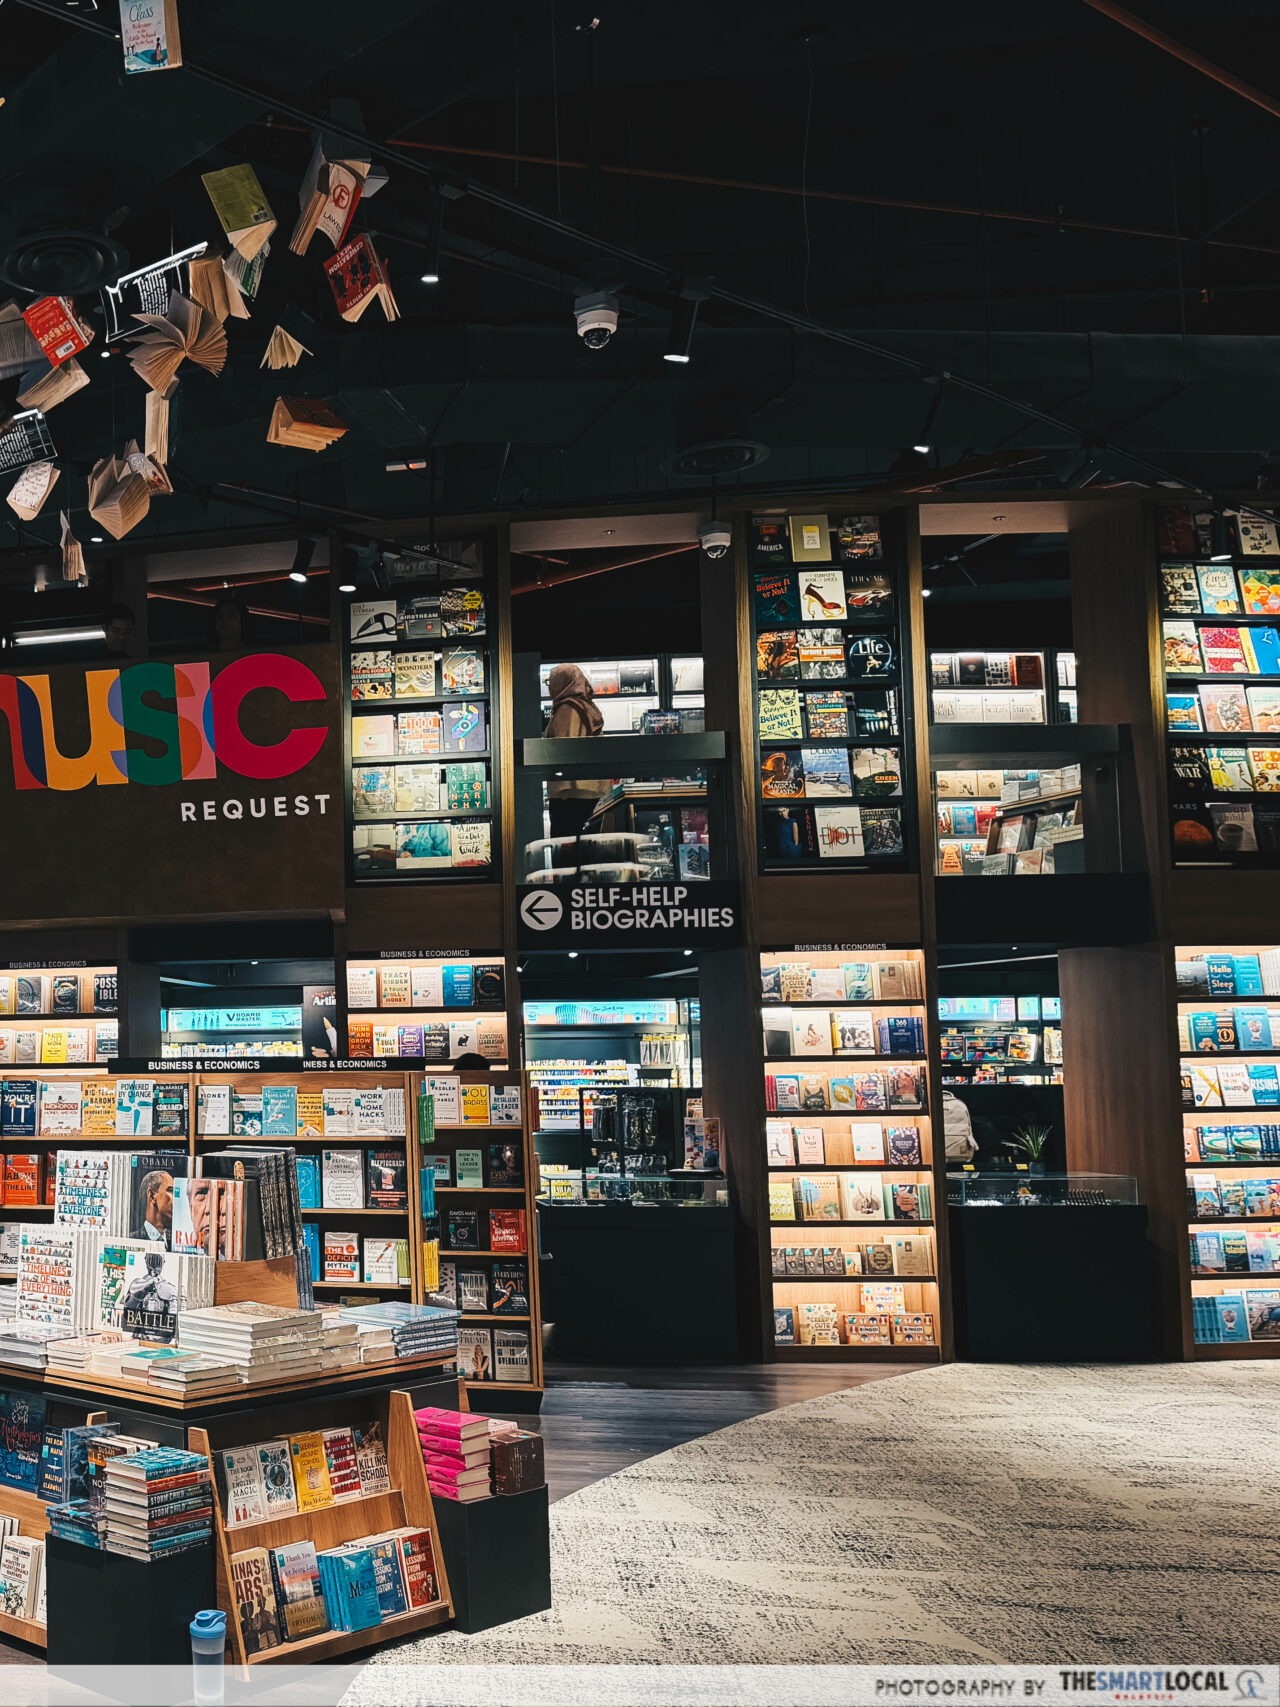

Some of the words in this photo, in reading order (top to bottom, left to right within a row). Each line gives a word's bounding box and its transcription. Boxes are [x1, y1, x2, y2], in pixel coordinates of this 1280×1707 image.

[129, 2, 154, 22] Class
[328, 241, 364, 274] GENERATION
[335, 244, 353, 262] NEXT
[757, 543, 784, 552] AMERICA
[756, 580, 782, 592] Believe
[772, 587, 788, 597] Not!
[399, 612, 439, 620] AIRSTREAM
[858, 639, 885, 654] Life
[397, 663, 433, 672] WONDERS
[759, 712, 789, 724] Believe
[789, 708, 798, 718] It
[408, 718, 434, 729] 1000
[767, 723, 776, 731] or
[777, 718, 795, 729] Not!
[1174, 767, 1203, 779] WAR
[180, 794, 331, 822] REQUEST
[459, 845, 481, 855] Walk
[570, 886, 688, 908] SELF-HELP
[570, 907, 735, 931] BIOGRAPHIES
[794, 943, 832, 951] BUSINESS
[840, 943, 887, 951] ECONOMICS
[380, 950, 417, 958] BUSINESS
[425, 949, 470, 957] ECONOMICS
[9, 961, 40, 969] BUSINESS
[48, 960, 87, 968] ECONOMICS
[1209, 964, 1232, 973] Hello
[94, 977, 118, 989] POSS
[1211, 979, 1234, 990] Sleep
[100, 988, 118, 1000] IBLE
[148, 1060, 194, 1070] BUSINESS
[195, 1060, 203, 1070] &
[204, 1060, 261, 1070] ECONOMICS
[303, 1060, 327, 1069] INESS
[328, 1060, 336, 1068] &
[336, 1060, 387, 1069] ECONOMICS
[120, 1083, 150, 1091] POWERED
[1249, 1078, 1278, 1091] RISING
[128, 1090, 152, 1098] CHANGE
[360, 1092, 384, 1100] WORK
[466, 1088, 488, 1097] YOU
[4, 1094, 36, 1104] YOU'RE
[44, 1102, 78, 1110] MONOPOLY
[141, 1157, 175, 1167] OBAMA
[6, 1172, 36, 1181] ABOVE
[6, 1183, 21, 1191] THE
[64, 1186, 103, 1196] TIMELINES
[77, 1196, 87, 1205] OF
[63, 1205, 103, 1216] EVERYONE
[175, 1230, 205, 1248] RAGE
[26, 1263, 67, 1276] TIMELINES
[40, 1274, 50, 1284] OF
[21, 1282, 72, 1297] EVERYTHING
[125, 1309, 176, 1329] BATTLE
[299, 1441, 318, 1451] SEEING
[300, 1450, 319, 1458] AROUND
[301, 1457, 320, 1466] CORNERS
[358, 1454, 388, 1470] KILLING
[240, 1465, 254, 1474] BOOK
[360, 1467, 389, 1482] SCHOOL
[232, 1478, 256, 1489] ENGLISH
[232, 1485, 258, 1498] MAGIC
[150, 1492, 169, 1506] STORM
[169, 1490, 185, 1501] CHILD
[150, 1506, 169, 1519] STORM
[168, 1503, 186, 1515] CHILD
[285, 1553, 302, 1563] Thank
[302, 1551, 311, 1560] You
[406, 1554, 427, 1567] LESSONS
[407, 1564, 421, 1574] FROM
[408, 1570, 427, 1584] HISTORY
[289, 1604, 315, 1616] THOMAS
[291, 1613, 327, 1628] FRIEDMAN
